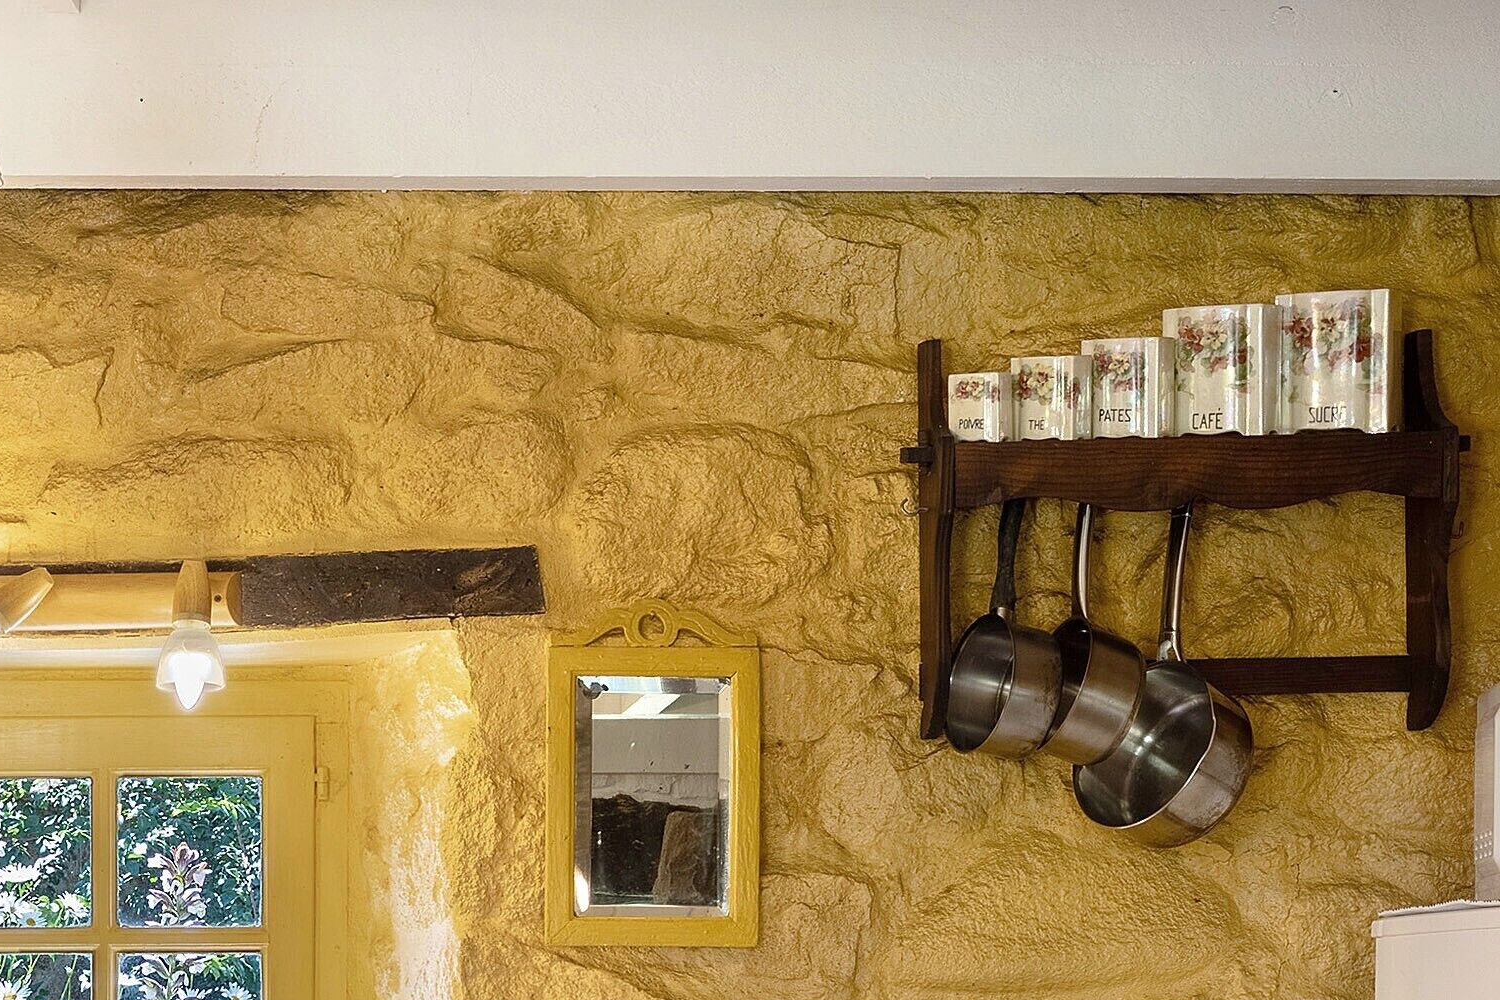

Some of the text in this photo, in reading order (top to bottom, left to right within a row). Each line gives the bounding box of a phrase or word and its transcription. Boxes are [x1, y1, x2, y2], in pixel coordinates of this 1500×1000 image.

[1098, 408, 1132, 423] PATES
[1192, 407, 1223, 430] CAFÉ
[958, 417, 985, 431] POIVRE
